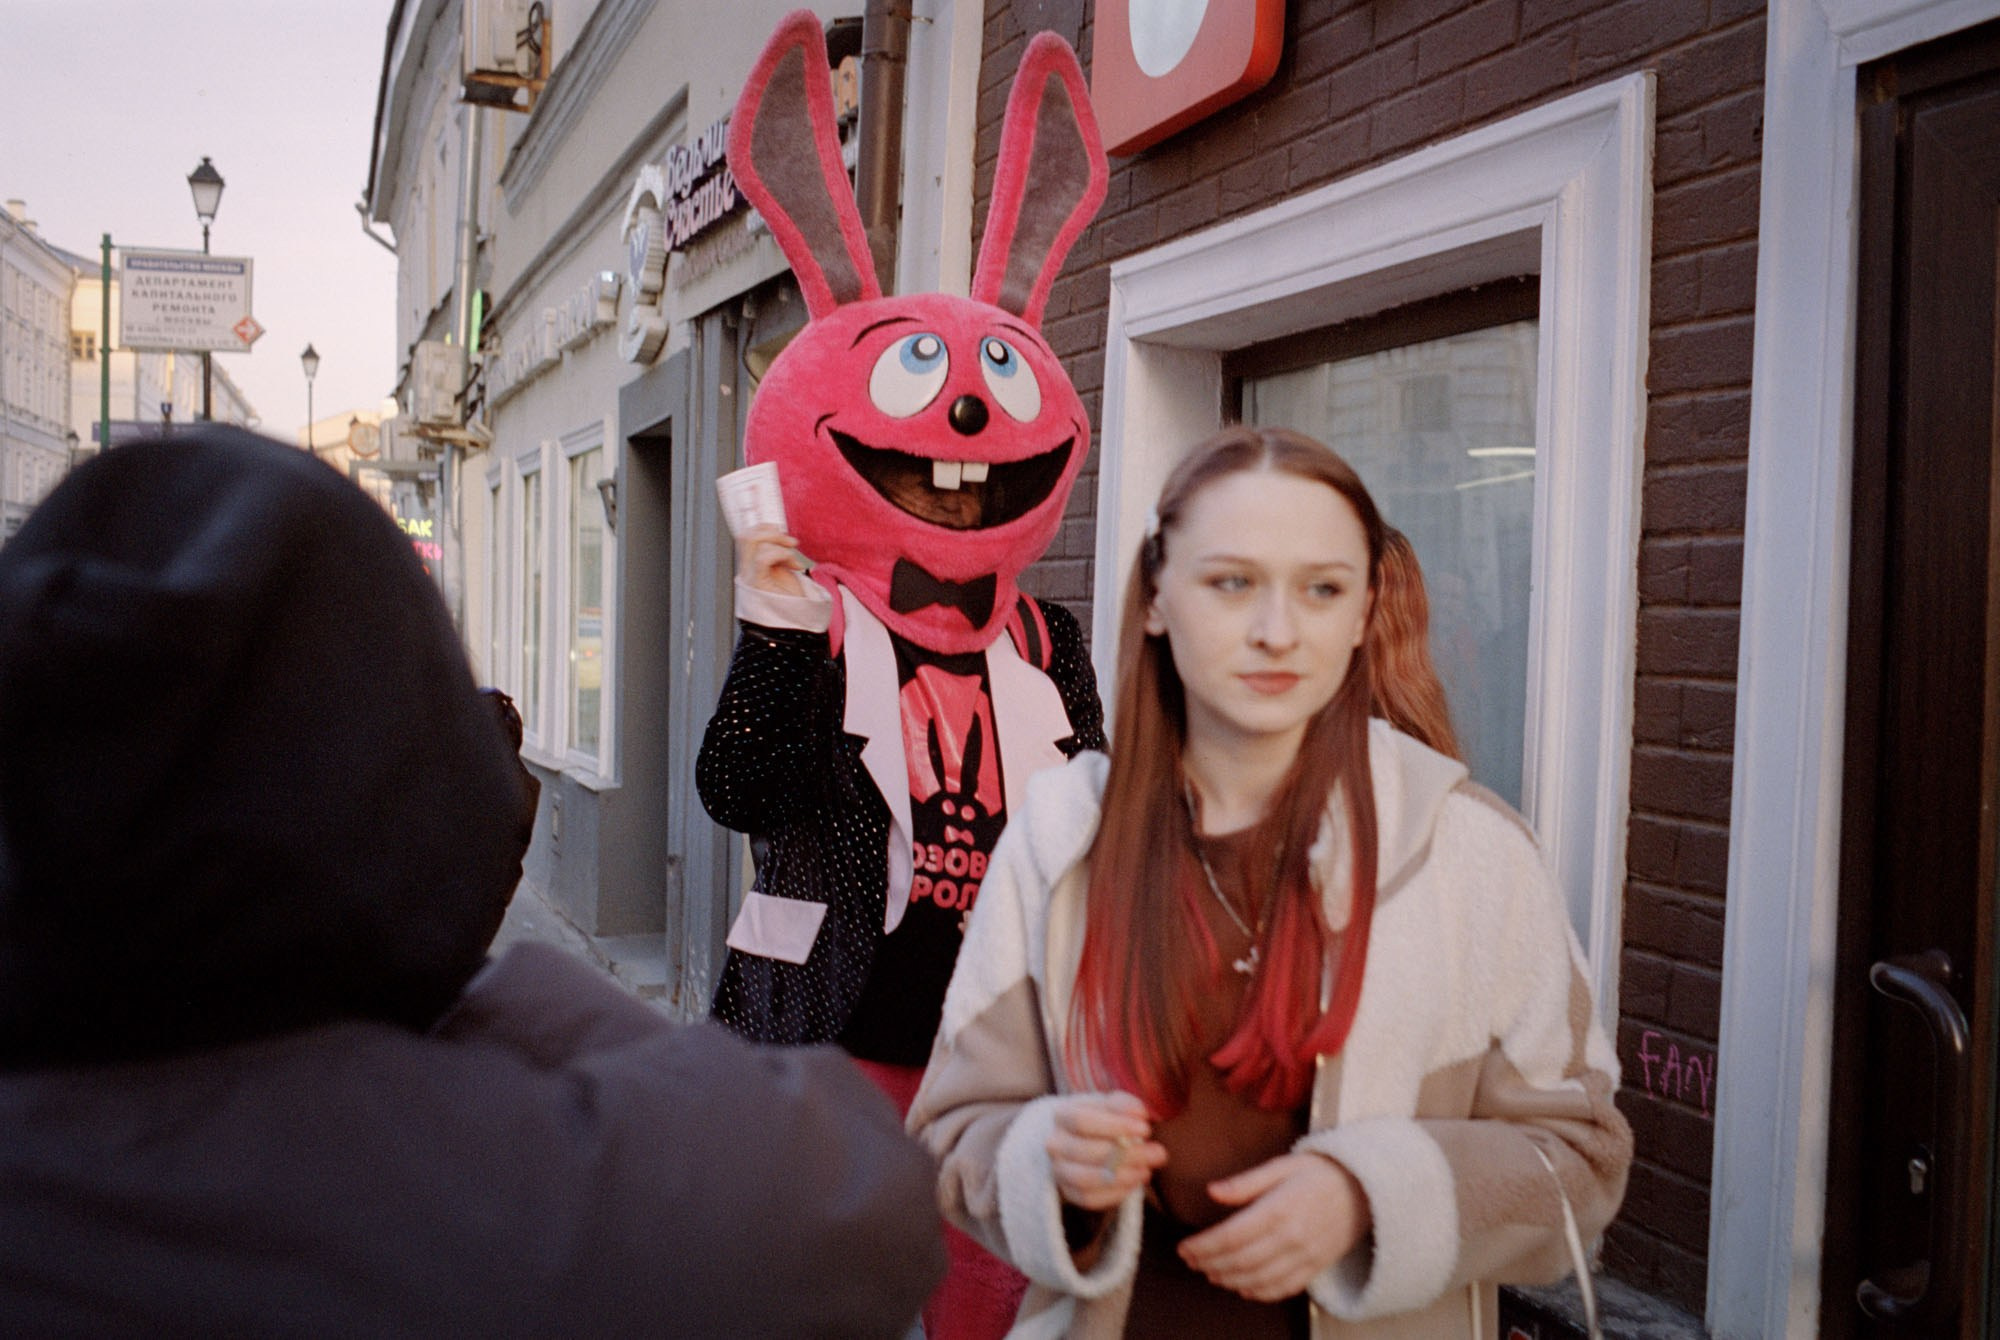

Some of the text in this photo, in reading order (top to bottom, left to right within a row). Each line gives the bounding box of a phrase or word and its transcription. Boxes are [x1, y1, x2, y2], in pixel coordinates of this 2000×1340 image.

[666, 120, 726, 202] Ведьми
[135, 275, 233, 289] ДЕПАРТАМЕНТ
[131, 289, 237, 303] КАПИТАЛЬНОГО
[152, 303, 216, 315] РЕМОНТА
[913, 841, 990, 880] ОЗОВ
